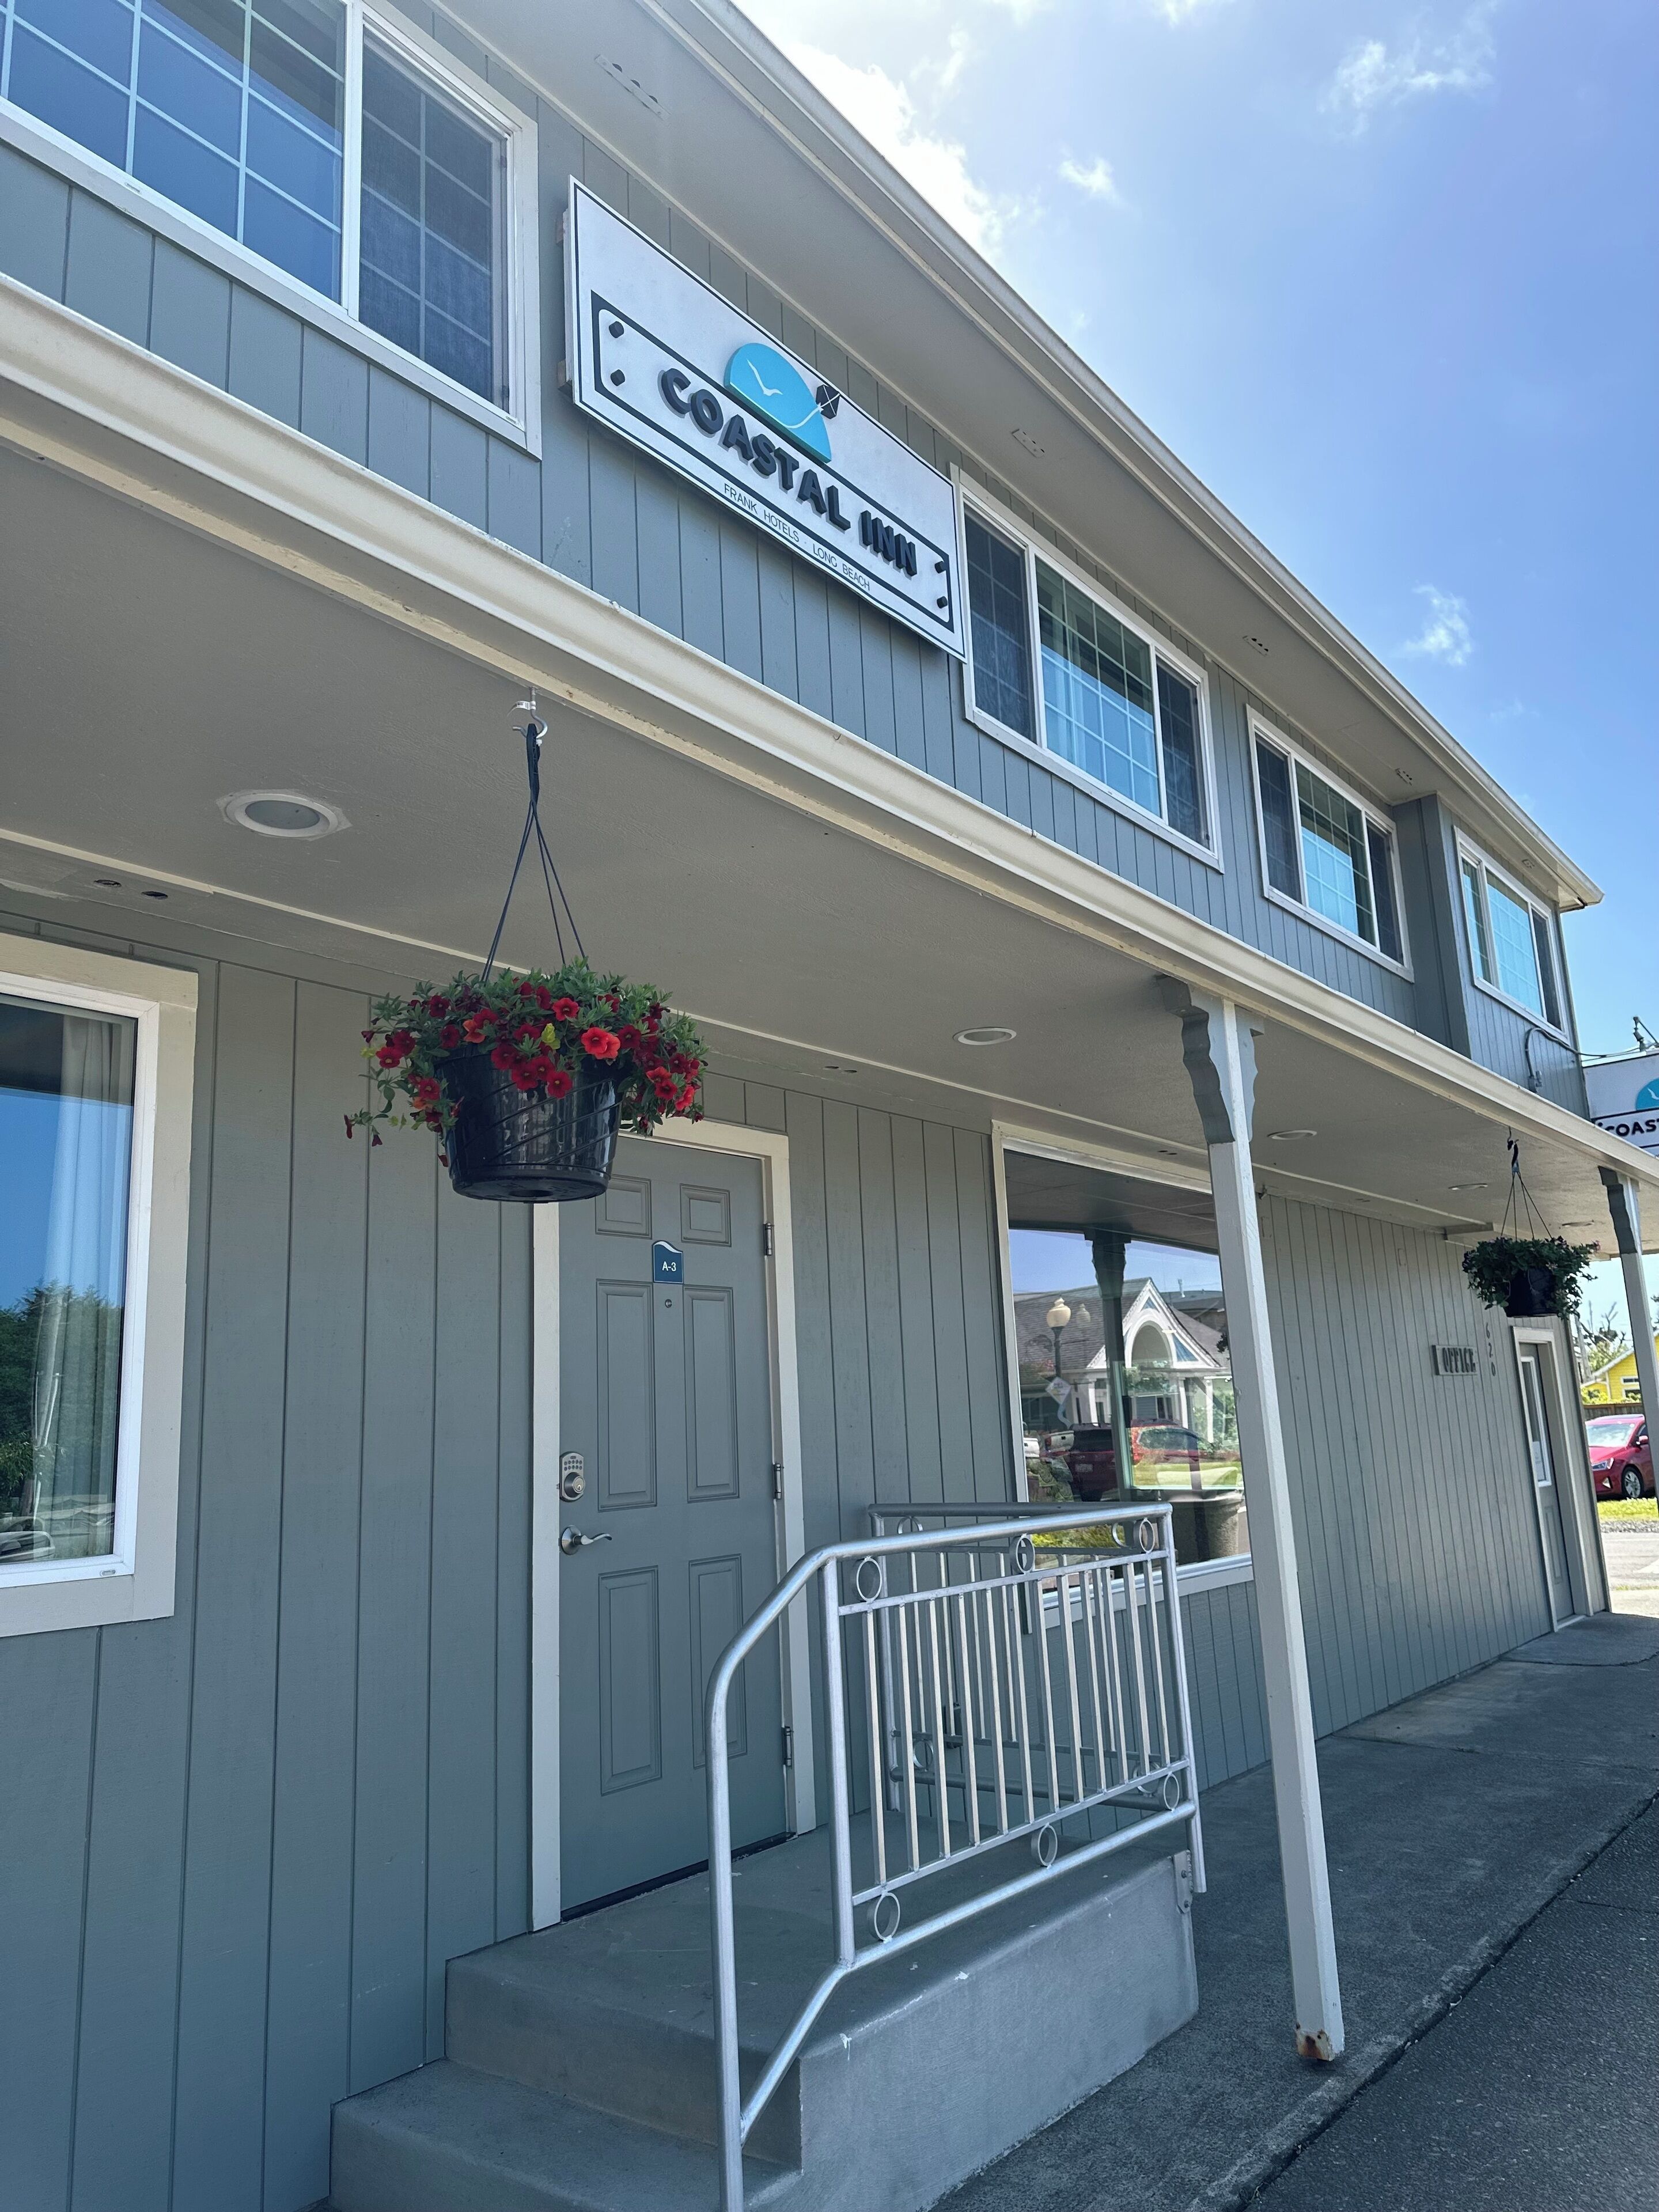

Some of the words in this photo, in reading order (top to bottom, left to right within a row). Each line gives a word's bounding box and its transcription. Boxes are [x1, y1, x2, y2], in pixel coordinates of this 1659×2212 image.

[660, 368, 851, 532] COASTAL
[860, 510, 918, 577] INN
[724, 483, 758, 514] FRANK
[763, 509, 800, 543] HOTELS
[812, 543, 838, 567] LONG
[842, 563, 870, 591] BEACH
[662, 1260, 677, 1272] A-3
[1442, 1347, 1476, 1373] OFFICE
